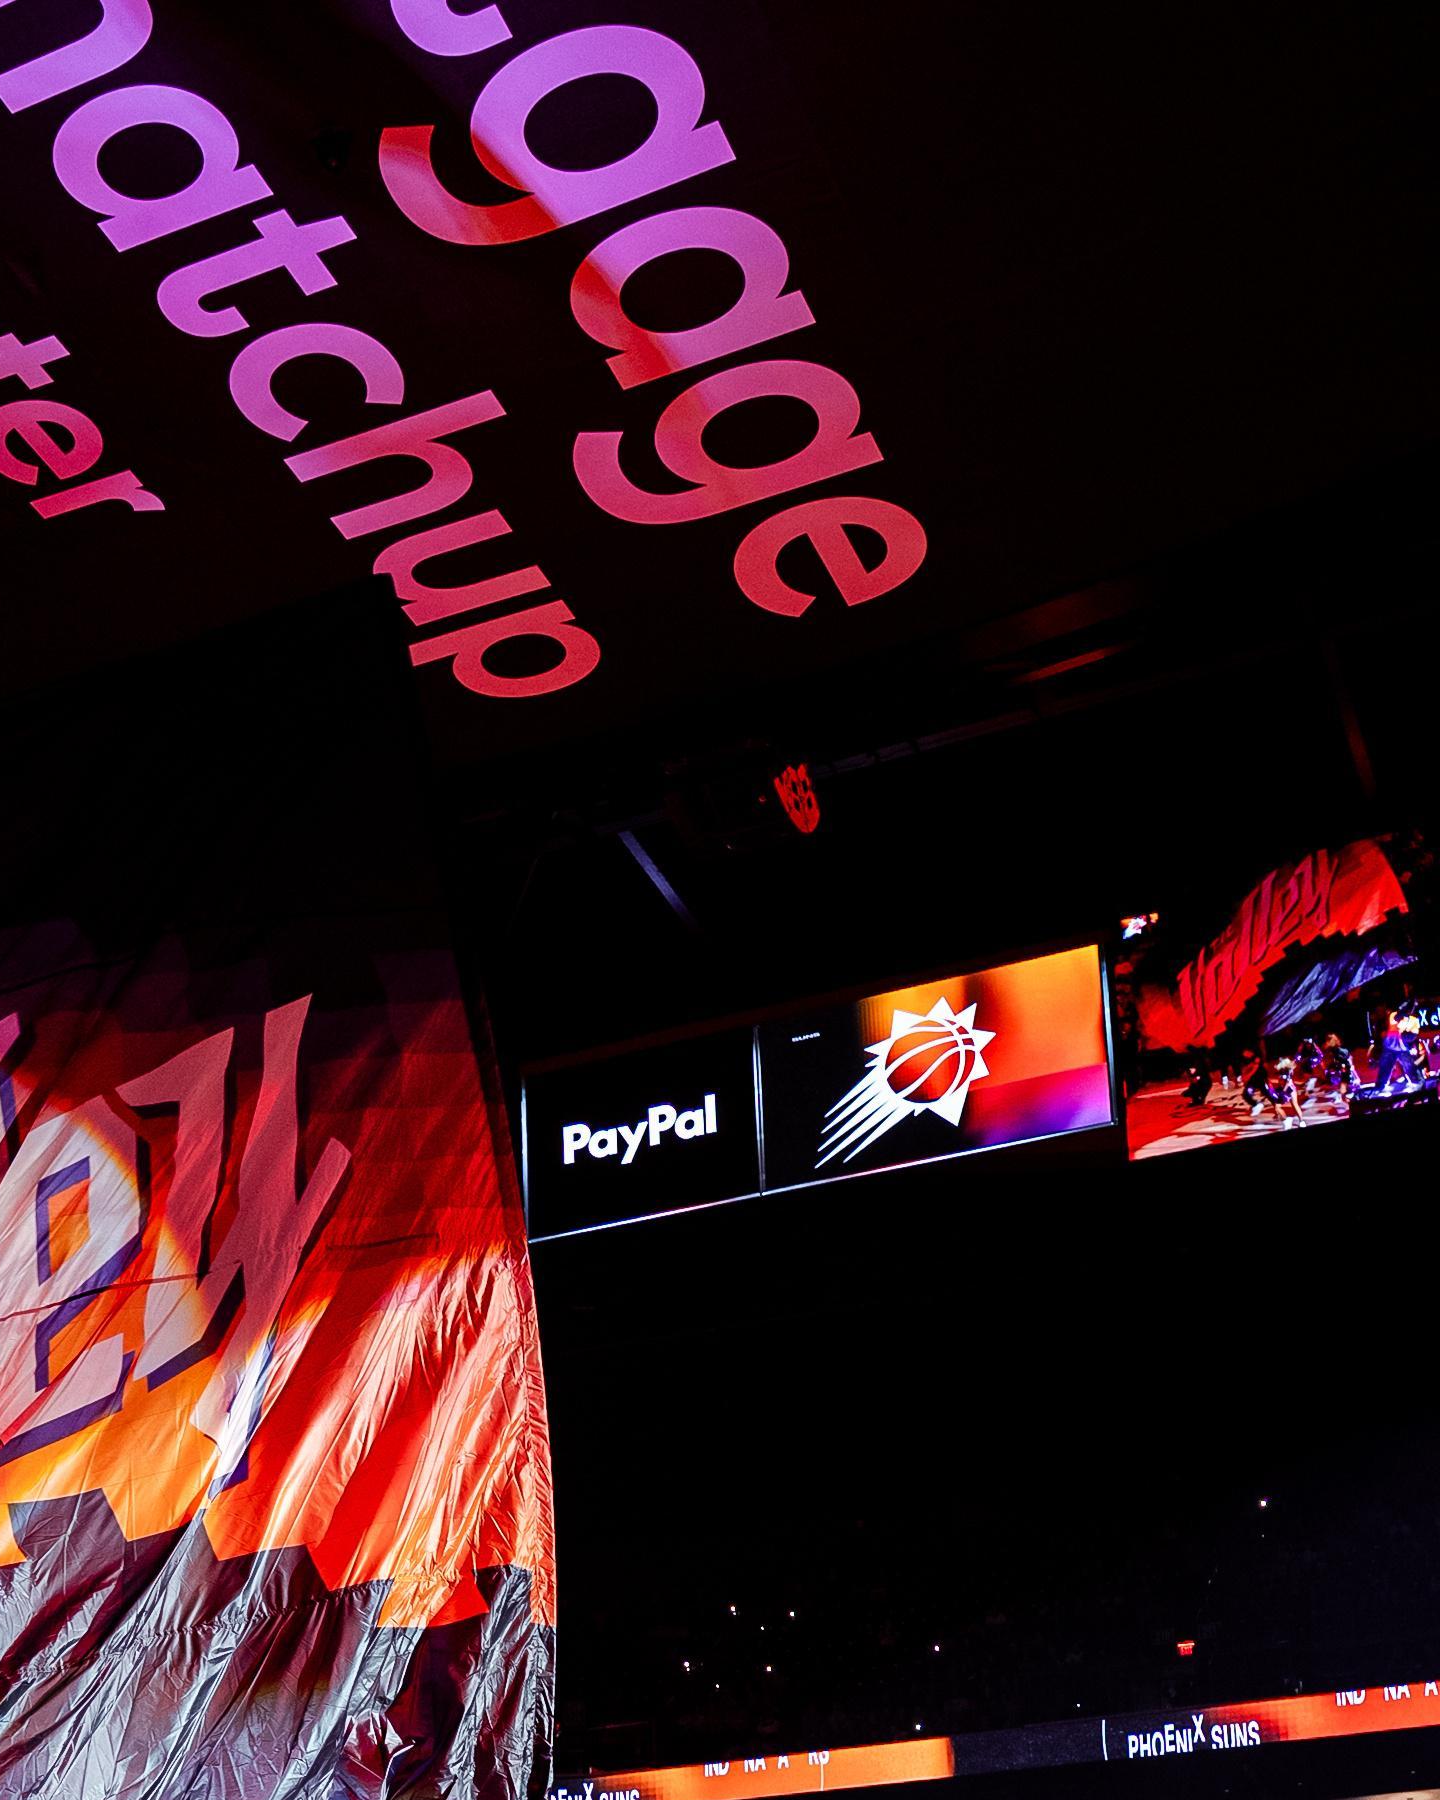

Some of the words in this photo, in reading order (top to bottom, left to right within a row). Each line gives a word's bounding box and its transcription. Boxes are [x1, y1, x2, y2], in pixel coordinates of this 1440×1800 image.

[561, 1093, 718, 1165] PayPal
[1127, 1713, 1206, 1759] PHOENIX
[1210, 1720, 1261, 1750] SUNS
